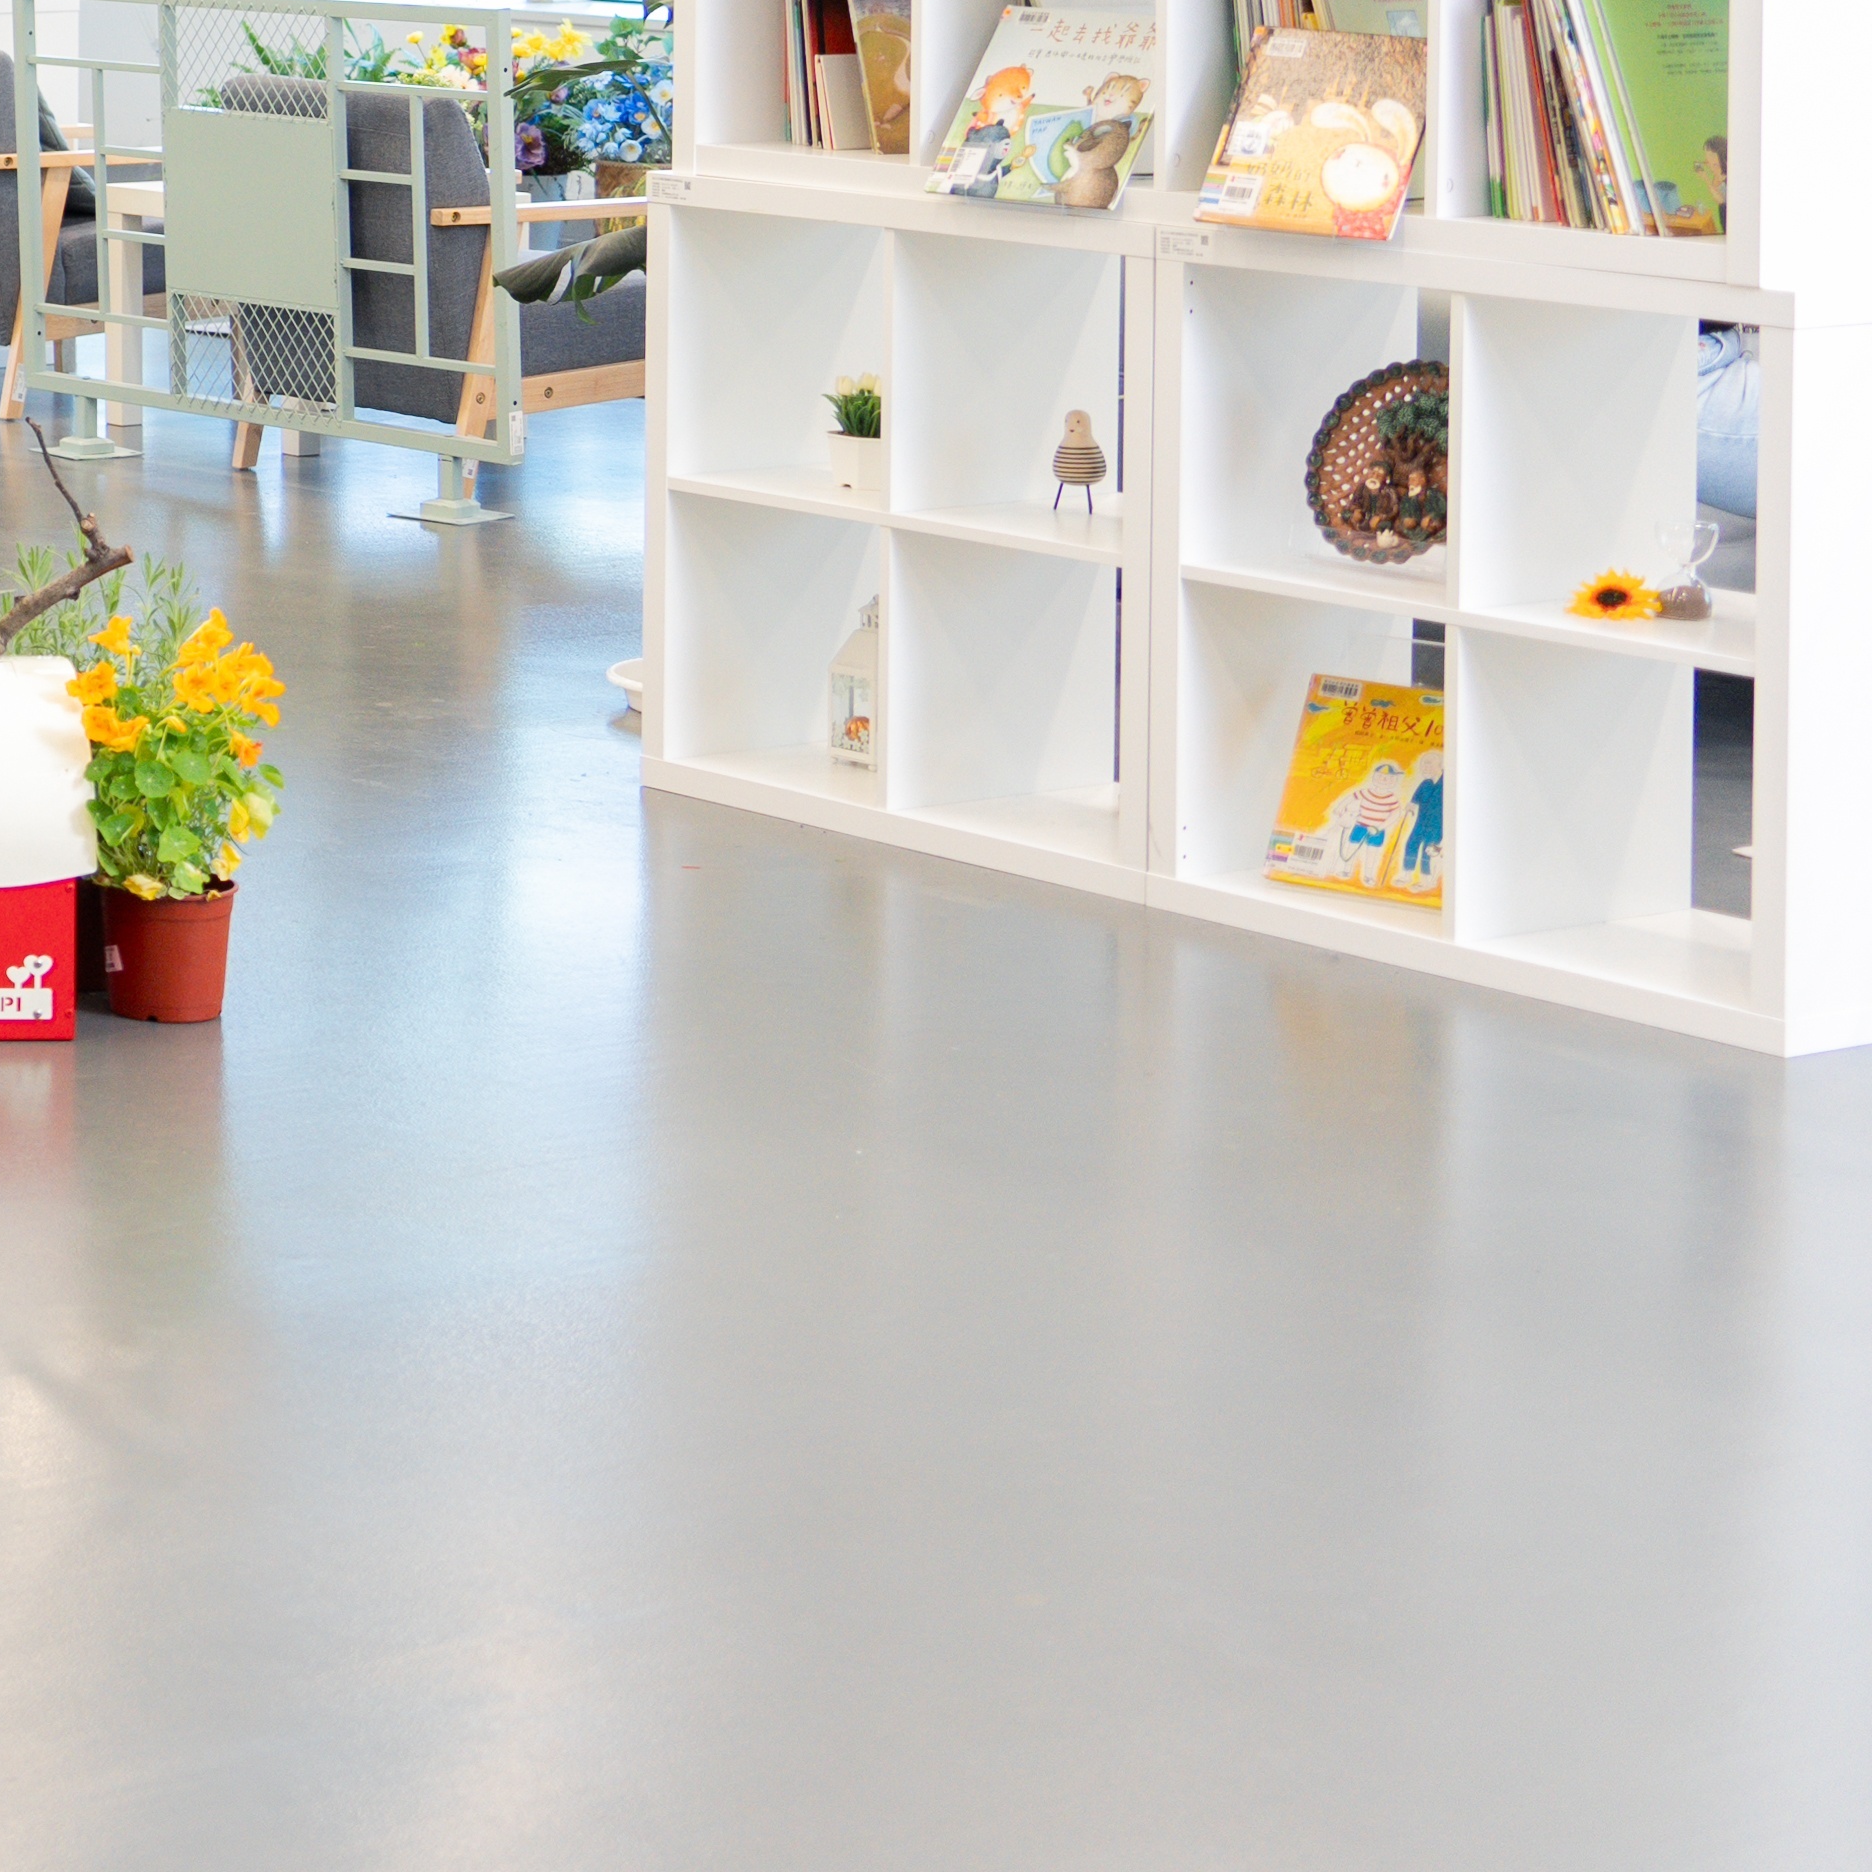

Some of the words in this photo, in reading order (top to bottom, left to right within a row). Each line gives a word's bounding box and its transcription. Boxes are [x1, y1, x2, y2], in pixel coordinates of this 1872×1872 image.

[1029, 18, 1157, 51] 一起去找爺爺
[1264, 183, 1313, 212] 森林
